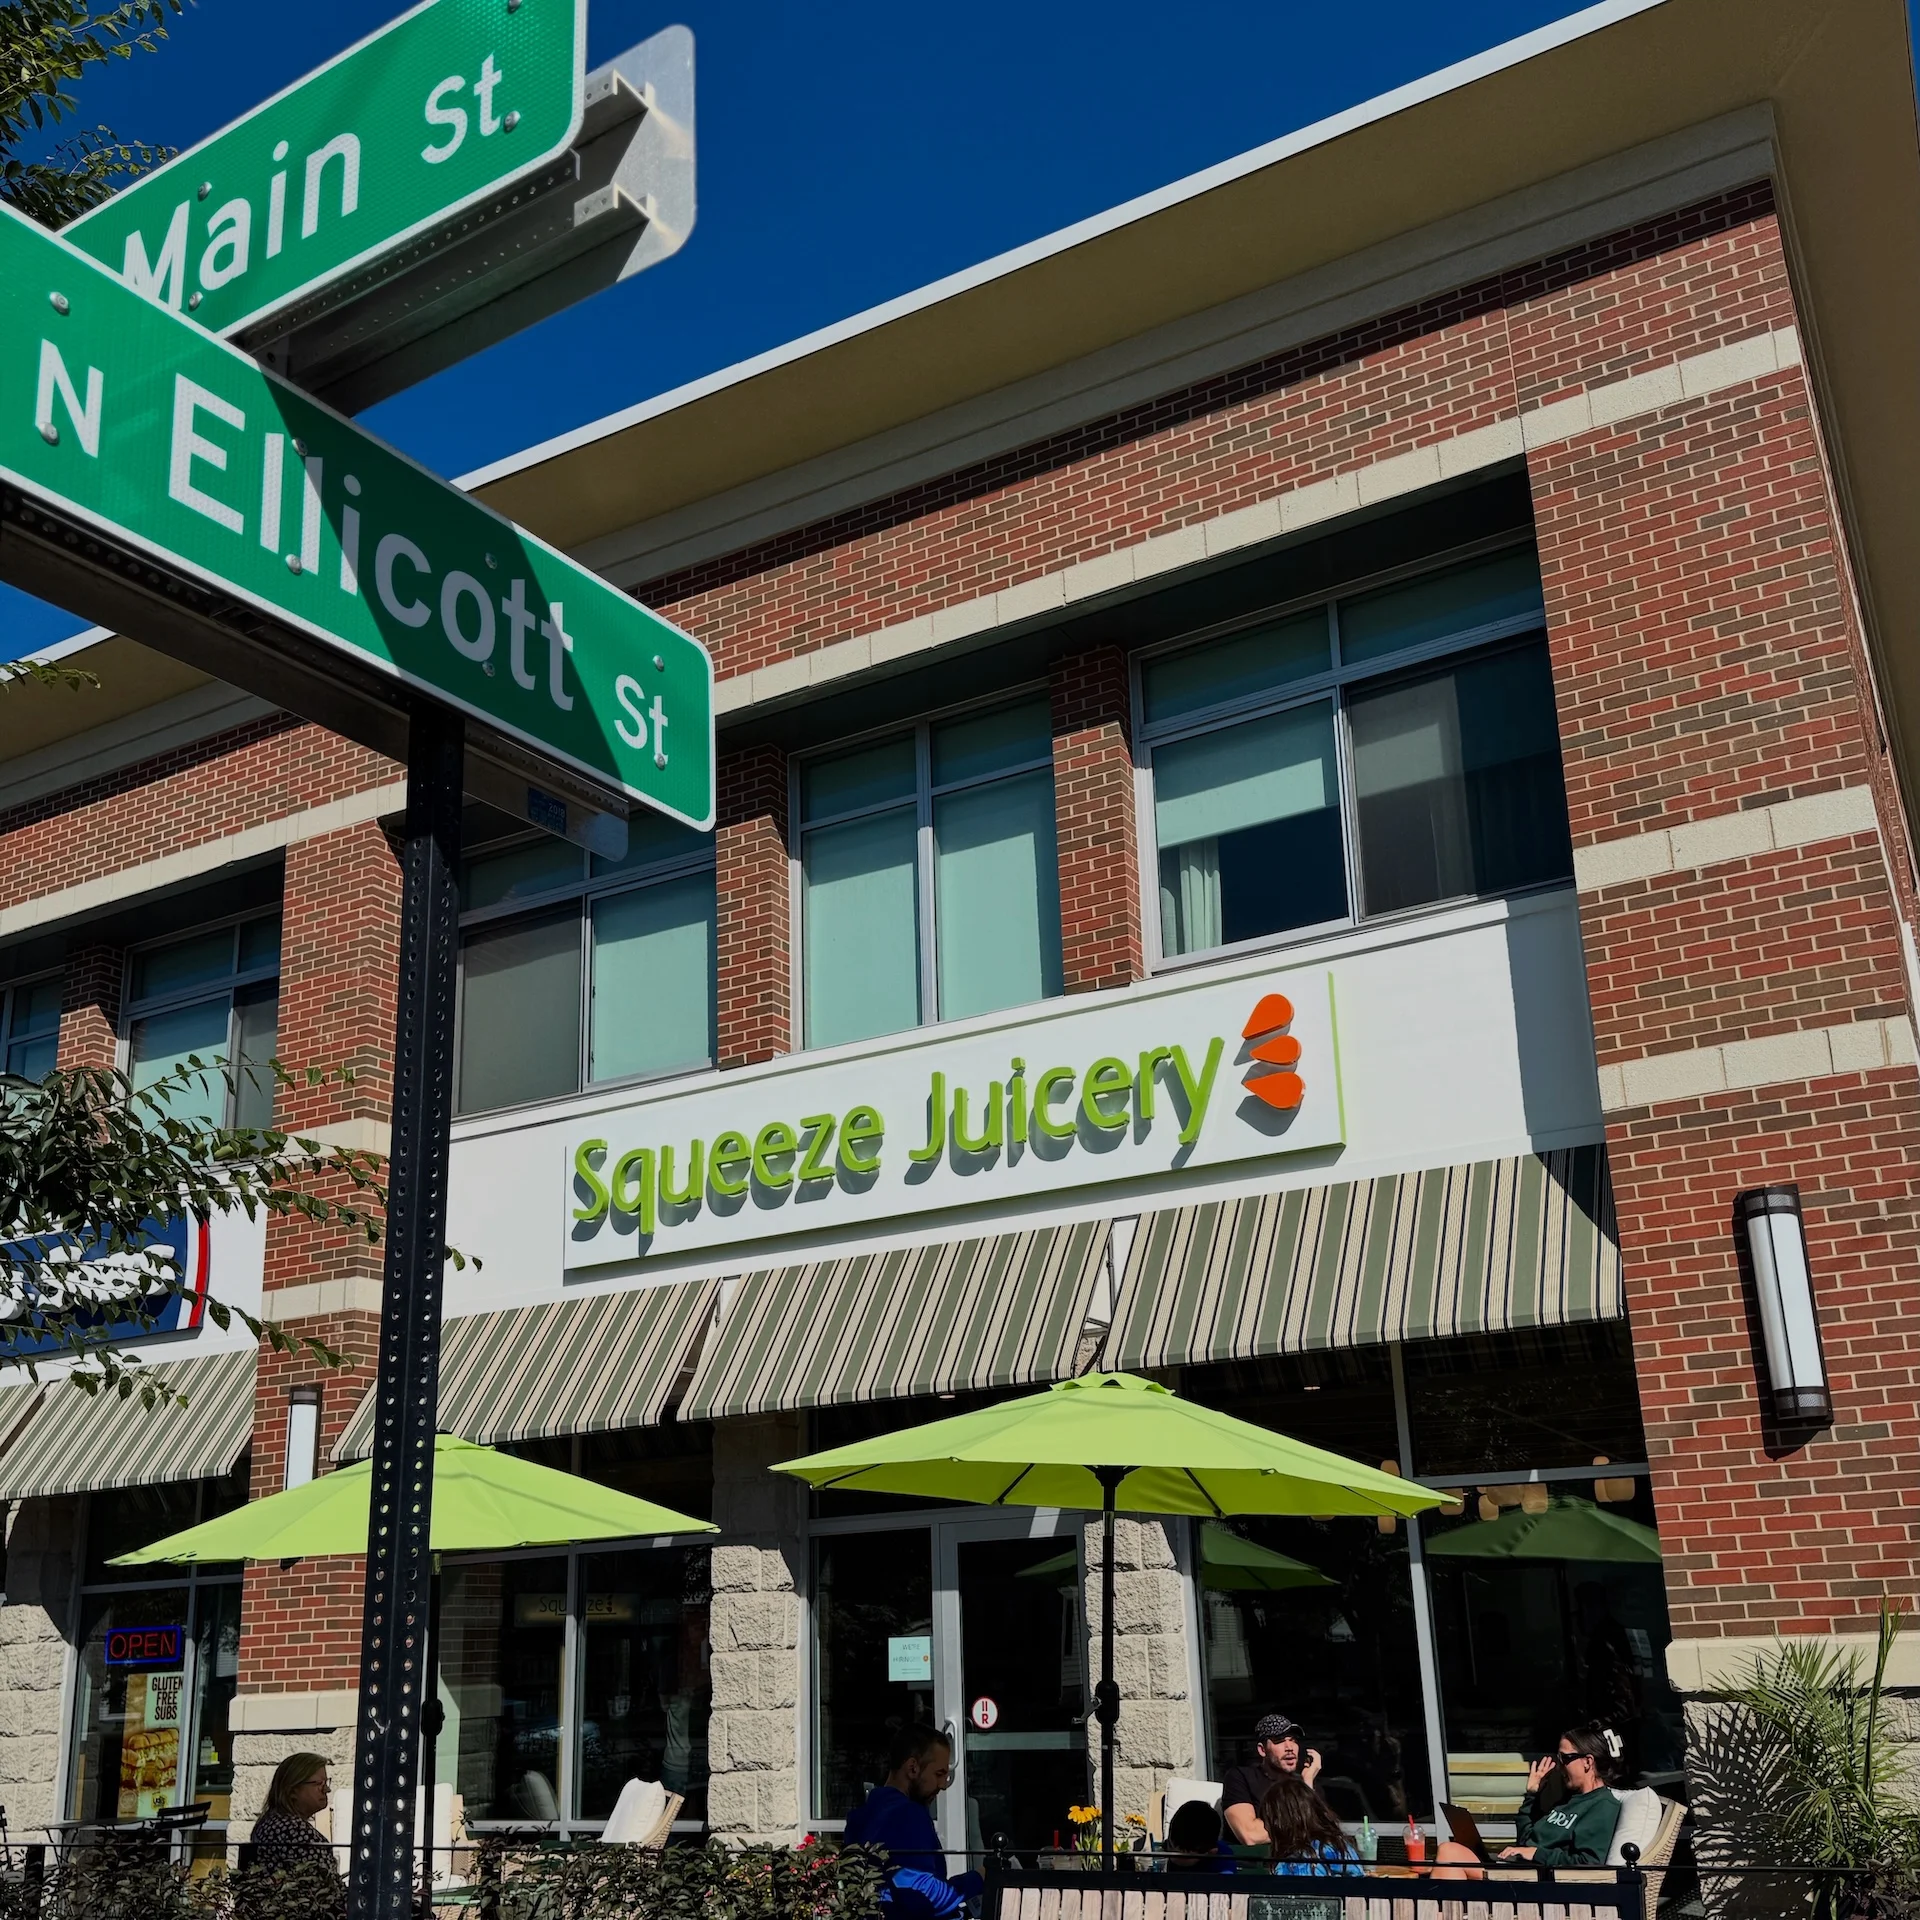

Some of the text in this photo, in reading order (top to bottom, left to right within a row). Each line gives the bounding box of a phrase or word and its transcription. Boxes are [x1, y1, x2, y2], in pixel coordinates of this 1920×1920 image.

[122, 131, 361, 312] Main
[34, 338, 669, 766] N Ellicott St
[571, 1037, 1225, 1235] Squeeze Juicery
[539, 1596, 604, 1616] Squze
[110, 1633, 177, 1658] OPEN
[152, 1676, 184, 1691] GLUTEN
[156, 1691, 178, 1706] FREE
[155, 1705, 177, 1720] SUBS
